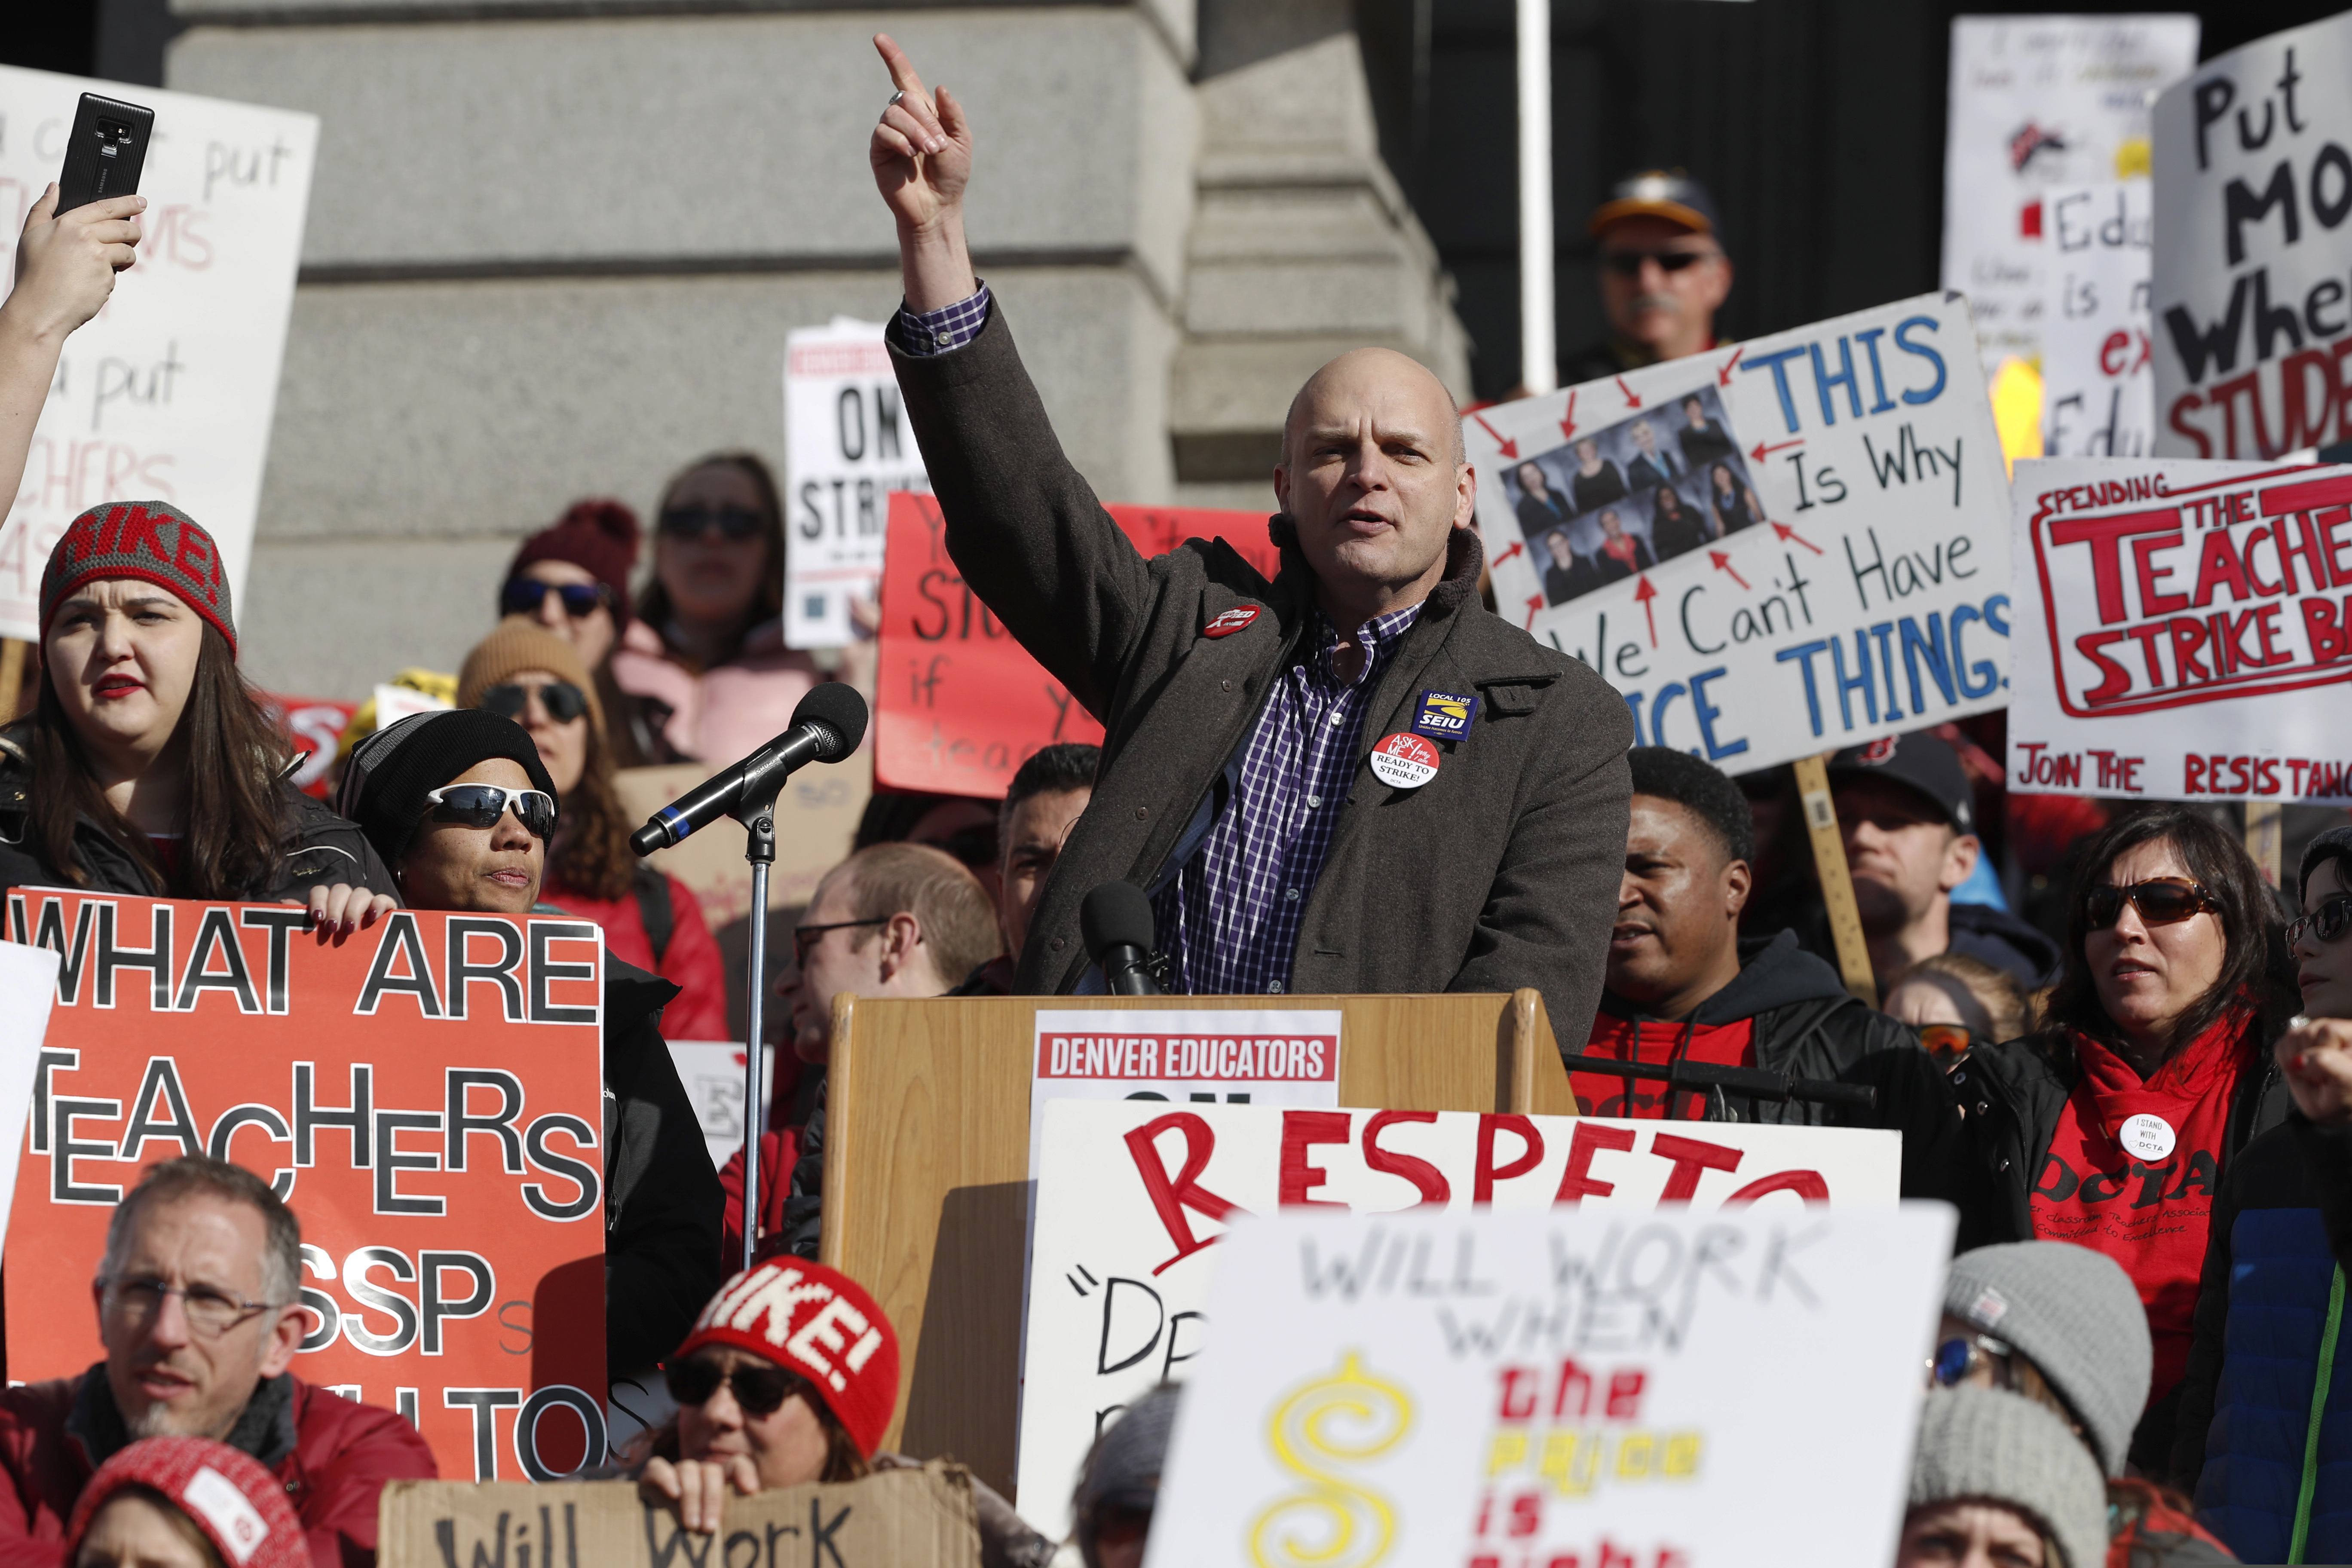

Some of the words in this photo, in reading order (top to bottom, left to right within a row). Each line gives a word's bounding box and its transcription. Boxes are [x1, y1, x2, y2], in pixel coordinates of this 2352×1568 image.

[2193, 45, 2308, 172] Put
[98, 168, 108, 193] SAMSUNG
[203, 134, 294, 204] put
[2164, 266, 2352, 386] Whe
[90, 340, 187, 433] put
[1740, 315, 1948, 434] THIS
[836, 385, 903, 462] ON
[1787, 450, 1847, 512] Is
[1864, 423, 1963, 508] Why
[2037, 473, 2169, 516] SPENDING
[2184, 489, 2256, 530] THE
[1681, 552, 1813, 656] Can't
[1844, 526, 1978, 611] Have
[910, 653, 952, 710] if
[2075, 602, 2294, 707] STRIKE
[1419, 714, 1465, 729] SEIU
[1429, 692, 1454, 701] LOCAL
[1624, 667, 1749, 762] ICE
[1377, 755, 1413, 769] READY
[1415, 765, 1430, 775] TO
[1387, 743, 1406, 757] ME
[1390, 734, 1417, 749] ASK
[2017, 742, 2081, 787] JOIN
[2088, 749, 2146, 793] THE
[1379, 765, 1420, 782] STRIKE!
[7, 894, 316, 1016] WHAT
[352, 910, 600, 1026] ARE
[1050, 1037, 1158, 1077] DENVER
[1164, 1038, 1325, 1079] EDUCATORS
[28, 1046, 602, 1223] TEACHERS
[2139, 1141, 2164, 1152] DCTA
[2140, 1130, 2156, 1140] WITH
[2141, 1118, 2162, 1130] STAND
[2032, 1149, 2219, 1210] DCTA
[2036, 1223, 2098, 1238] Committed
[2103, 1225, 2118, 1238] to
[2122, 1224, 2187, 1242] Excellence
[2109, 1211, 2158, 1228] Teachers
[1299, 1222, 1498, 1305] WILL
[1547, 1217, 1834, 1310] WORK
[1435, 1296, 1698, 1358] WHEN
[1497, 1356, 1651, 1424] the
[434, 1502, 579, 1568] Will
[643, 1497, 852, 1568] Work
